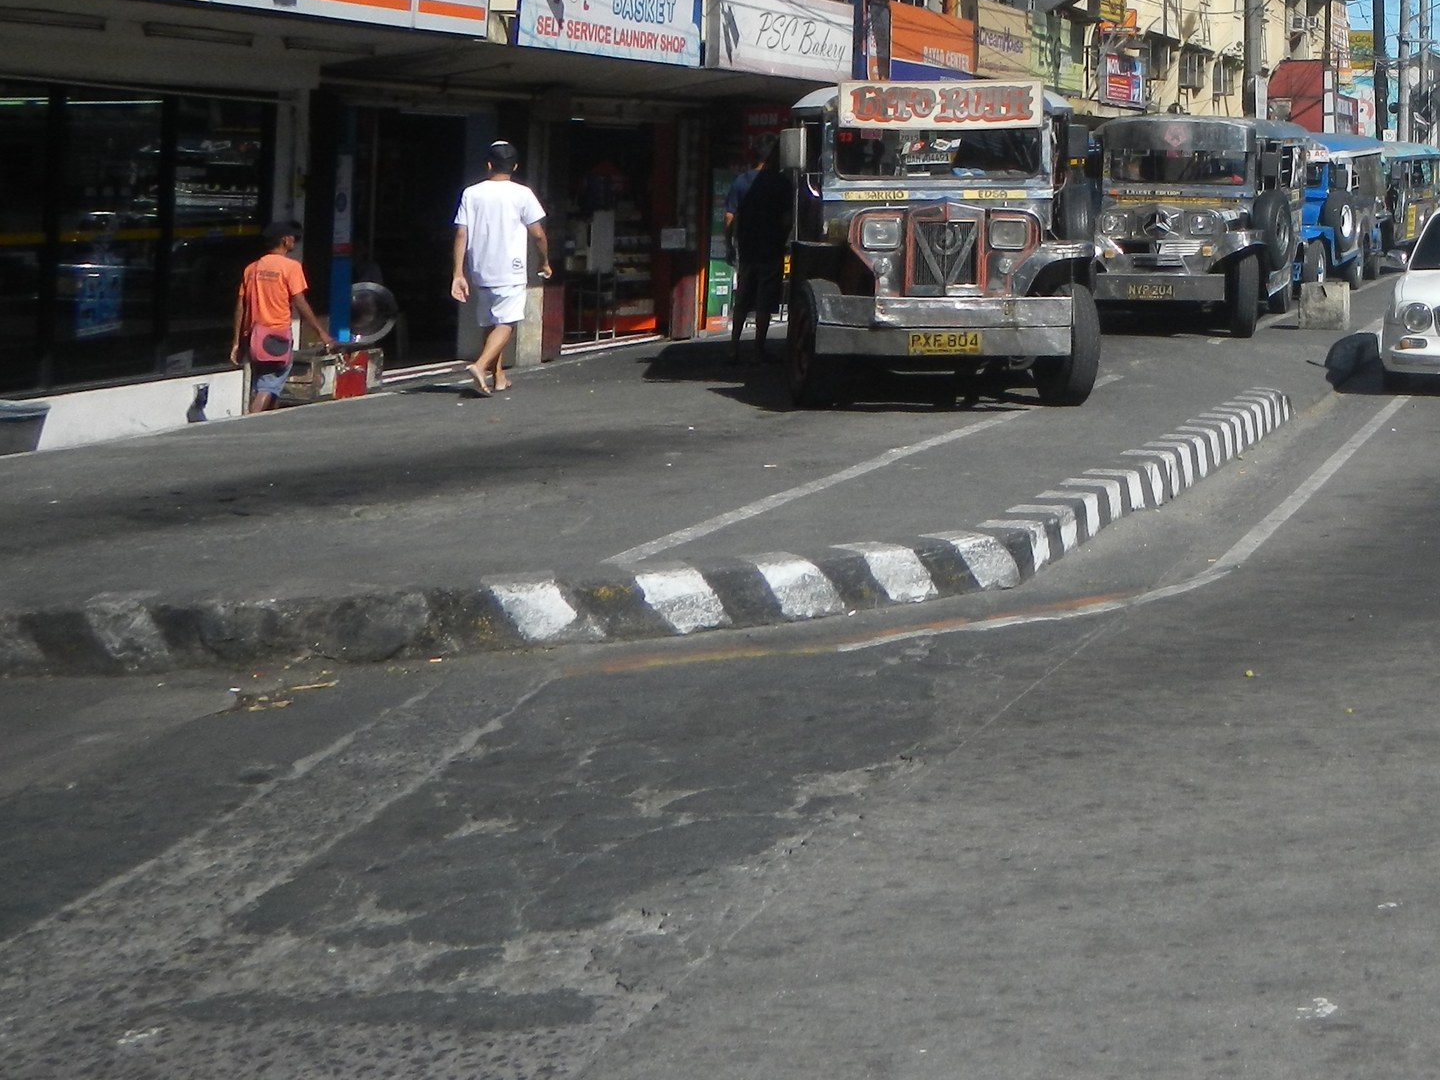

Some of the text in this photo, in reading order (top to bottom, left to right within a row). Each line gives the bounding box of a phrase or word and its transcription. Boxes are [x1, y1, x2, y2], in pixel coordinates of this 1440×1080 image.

[536, 15, 687, 54] SELF SERVICE LAUNDRY SHOP
[756, 12, 799, 52] PSC
[799, 21, 848, 71] Bakery
[945, 51, 970, 73] CENTER
[947, 333, 978, 348] 804
